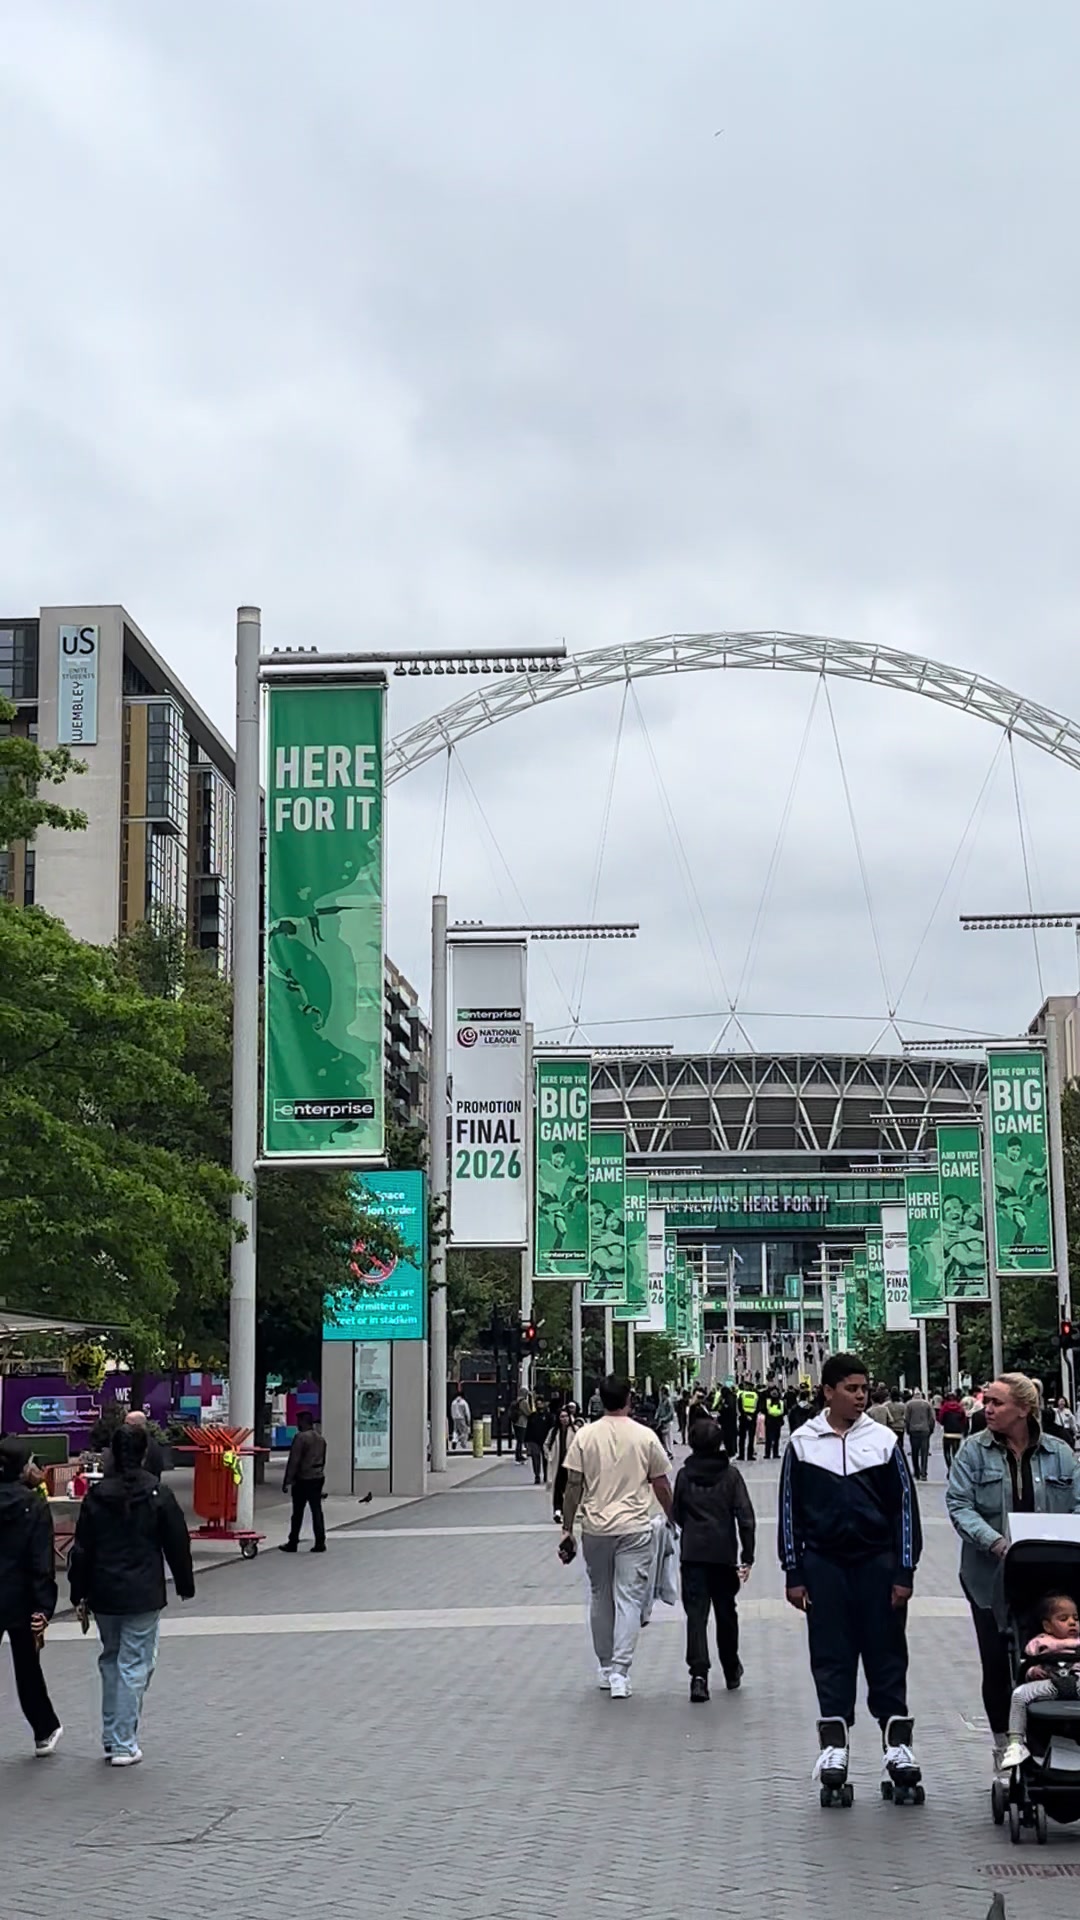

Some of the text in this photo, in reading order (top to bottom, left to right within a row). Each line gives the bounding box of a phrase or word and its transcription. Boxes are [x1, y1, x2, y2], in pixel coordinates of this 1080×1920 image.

[72, 681, 83, 743] WEMBLEY
[276, 745, 376, 789] HERE
[275, 796, 376, 832] FOR IT
[460, 1010, 521, 1019] enterprise
[484, 1036, 518, 1044] LEAGUE
[992, 1067, 1040, 1077] HERE FOR THE
[541, 1075, 587, 1084] HERE FOR THE
[993, 1079, 1042, 1111] BIG
[456, 1101, 522, 1113] PROMOTION
[541, 1087, 587, 1119] BIG
[279, 1102, 374, 1118] enterprise
[994, 1114, 1043, 1134] GAME
[456, 1119, 521, 1144] FINAL
[541, 1122, 587, 1142] GAME
[601, 1156, 623, 1165] EVERY
[941, 1151, 978, 1160] AND EVERY
[456, 1149, 522, 1179] 2026
[941, 1162, 979, 1177] GAME
[375, 1191, 405, 1202] Space
[624, 1196, 646, 1209] ERE
[908, 1192, 939, 1206] HERE
[743, 1195, 779, 1213] HERE
[783, 1195, 812, 1212] FOR
[814, 1194, 829, 1212] IT
[386, 1205, 416, 1215] Order
[636, 1210, 646, 1222] IT
[908, 1207, 940, 1219] FOR IT
[869, 1245, 882, 1261] BI
[886, 1277, 908, 1288] FINA
[399, 1288, 415, 1297] are
[651, 1292, 664, 1304] 26
[887, 1290, 908, 1302] 202
[353, 1302, 396, 1311] ermitted
[357, 1317, 368, 1325] or
[369, 1315, 379, 1325] in
[379, 1314, 418, 1325] stadium
[26, 1402, 50, 1410] College
[75, 1408, 100, 1416] London
